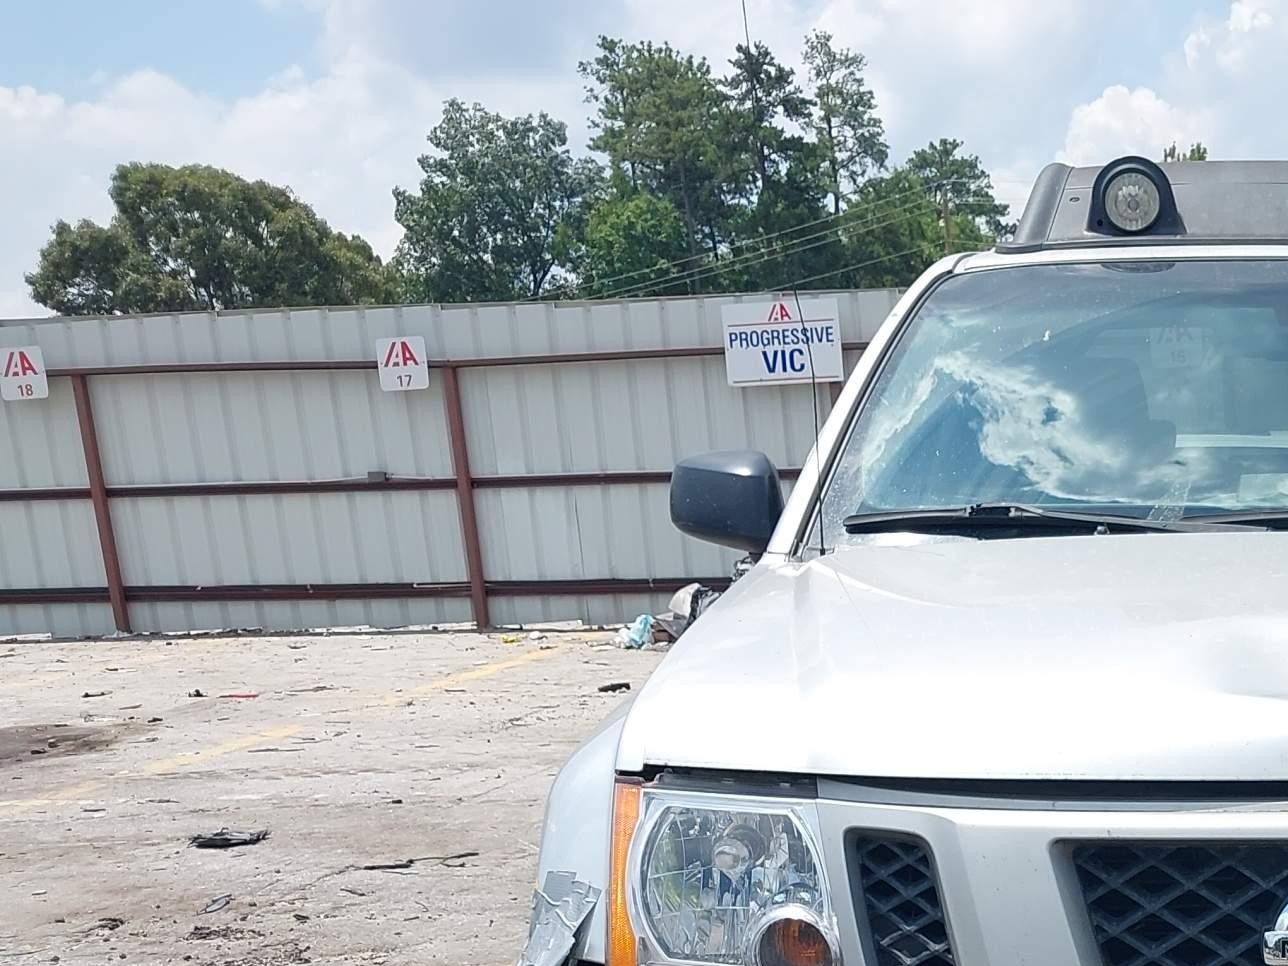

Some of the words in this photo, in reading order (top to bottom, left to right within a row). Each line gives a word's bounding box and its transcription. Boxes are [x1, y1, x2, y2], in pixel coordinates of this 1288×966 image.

[728, 326, 835, 349] PROGRESSIVE
[761, 348, 806, 374] VIC
[17, 383, 34, 397] 18
[396, 374, 412, 388] 17
